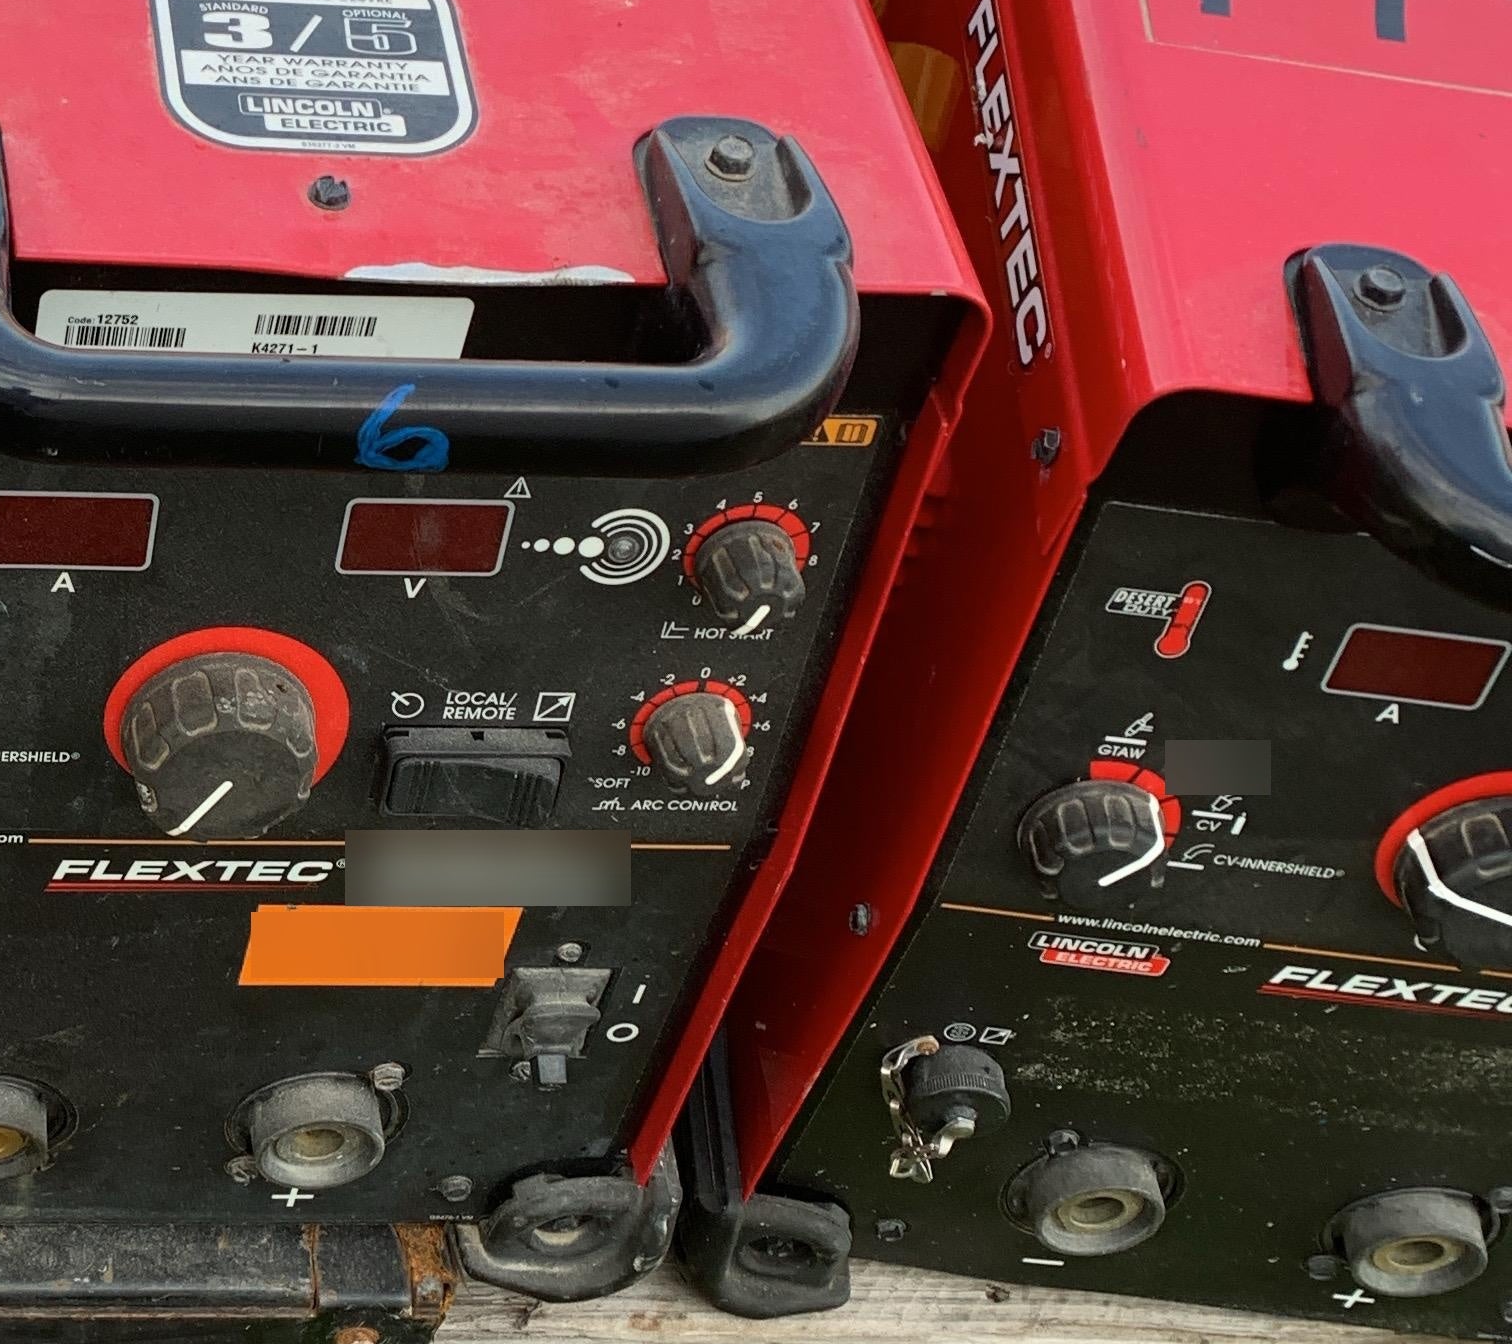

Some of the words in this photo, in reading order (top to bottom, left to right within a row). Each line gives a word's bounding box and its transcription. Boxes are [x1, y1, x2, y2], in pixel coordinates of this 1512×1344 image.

[199, 3, 269, 15] STANDARD
[342, 9, 408, 21] OPTIONAL
[202, 11, 274, 50] 3
[218, 54, 275, 65] YEAR
[283, 57, 409, 70] WARRANTY
[275, 67, 304, 77] DE
[215, 74, 261, 85] ANS
[269, 77, 300, 87] DE
[305, 79, 421, 93] GARANTIE
[246, 96, 376, 117] LINCOLN
[280, 118, 393, 133] ELECTRIC
[97, 314, 139, 325] 12752
[354, 383, 450, 472] 6
[716, 499, 727, 510] 4
[752, 492, 764, 504] 5
[788, 499, 799, 510] 6
[684, 523, 694, 535] 3
[810, 522, 821, 533] 7
[672, 549, 682, 561] 2
[808, 555, 819, 566] 8
[50, 571, 76, 593] A
[677, 575, 683, 586] 1
[403, 577, 427, 599] V
[1114, 590, 1177, 609] DESERT
[1123, 603, 1174, 617] DUTY
[694, 627, 727, 640] HOT
[700, 667, 711, 678] 0
[659, 673, 676, 686] -2
[728, 674, 747, 687] +2
[445, 691, 517, 708] LOCAL/
[630, 690, 645, 702] -4
[749, 692, 768, 704] +4
[442, 706, 517, 721] REMOTE
[1375, 703, 1400, 724] A
[611, 718, 626, 730] -6
[753, 719, 771, 731] +6
[611, 744, 627, 756] -8
[1097, 743, 1145, 760] GTAW
[630, 766, 651, 776] -10
[594, 777, 631, 789] SOFT
[630, 799, 665, 811] ARC
[1196, 819, 1222, 833] CV
[1057, 912, 1262, 949] www.lincolnelectric.com
[1036, 934, 1151, 959] LINCOLN
[1054, 951, 1154, 973] ELECTRIC
